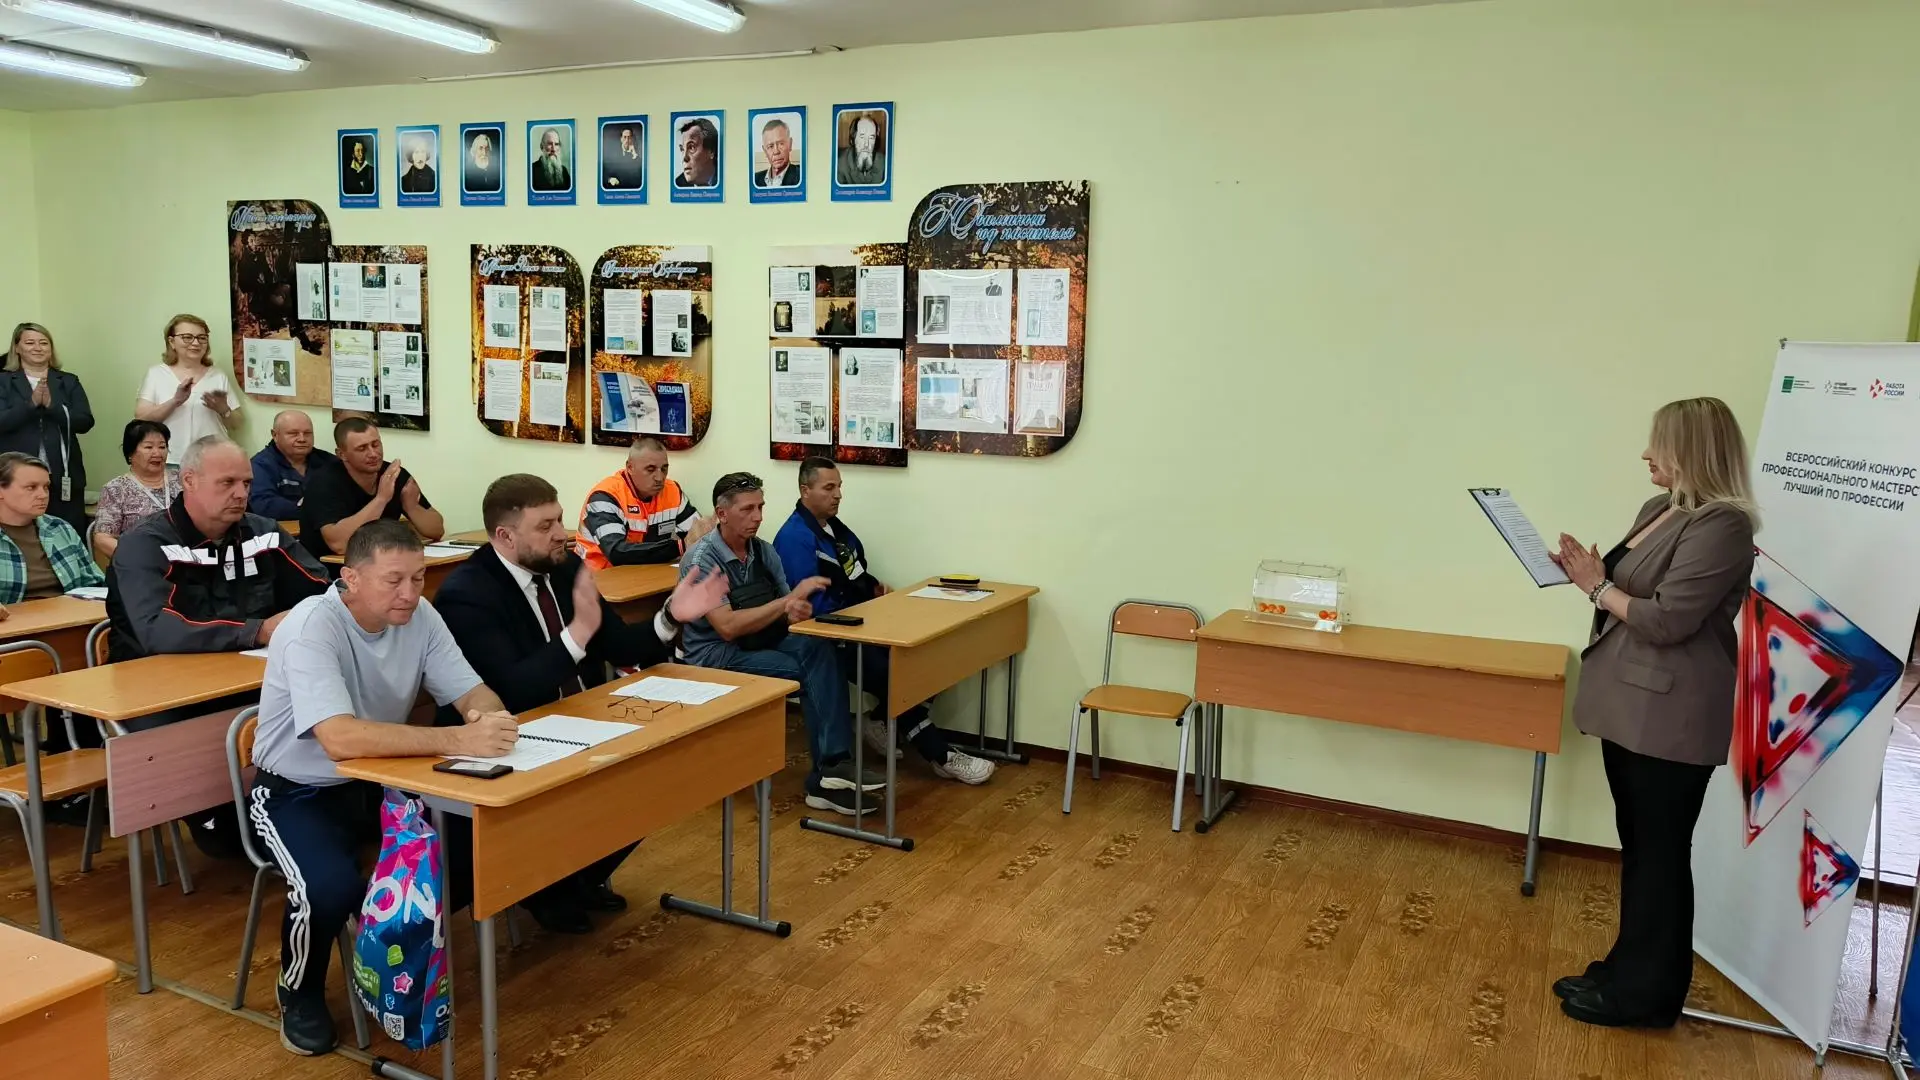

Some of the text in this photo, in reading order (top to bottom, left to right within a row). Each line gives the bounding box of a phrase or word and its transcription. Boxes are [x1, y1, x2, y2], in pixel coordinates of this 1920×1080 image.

[975, 225, 1076, 254] год писателя
[1883, 389, 1905, 397] РОССИИ
[1762, 462, 1920, 497] ПРОФЕССИОНАЛЬНОГО МАСТЕРС
[1785, 451, 1918, 479] ВСЕРОССИЙСКИЙ КОНКУРС
[1783, 480, 1905, 512] ЛУЧШИЙ ПО ПРОФЕССИИ
